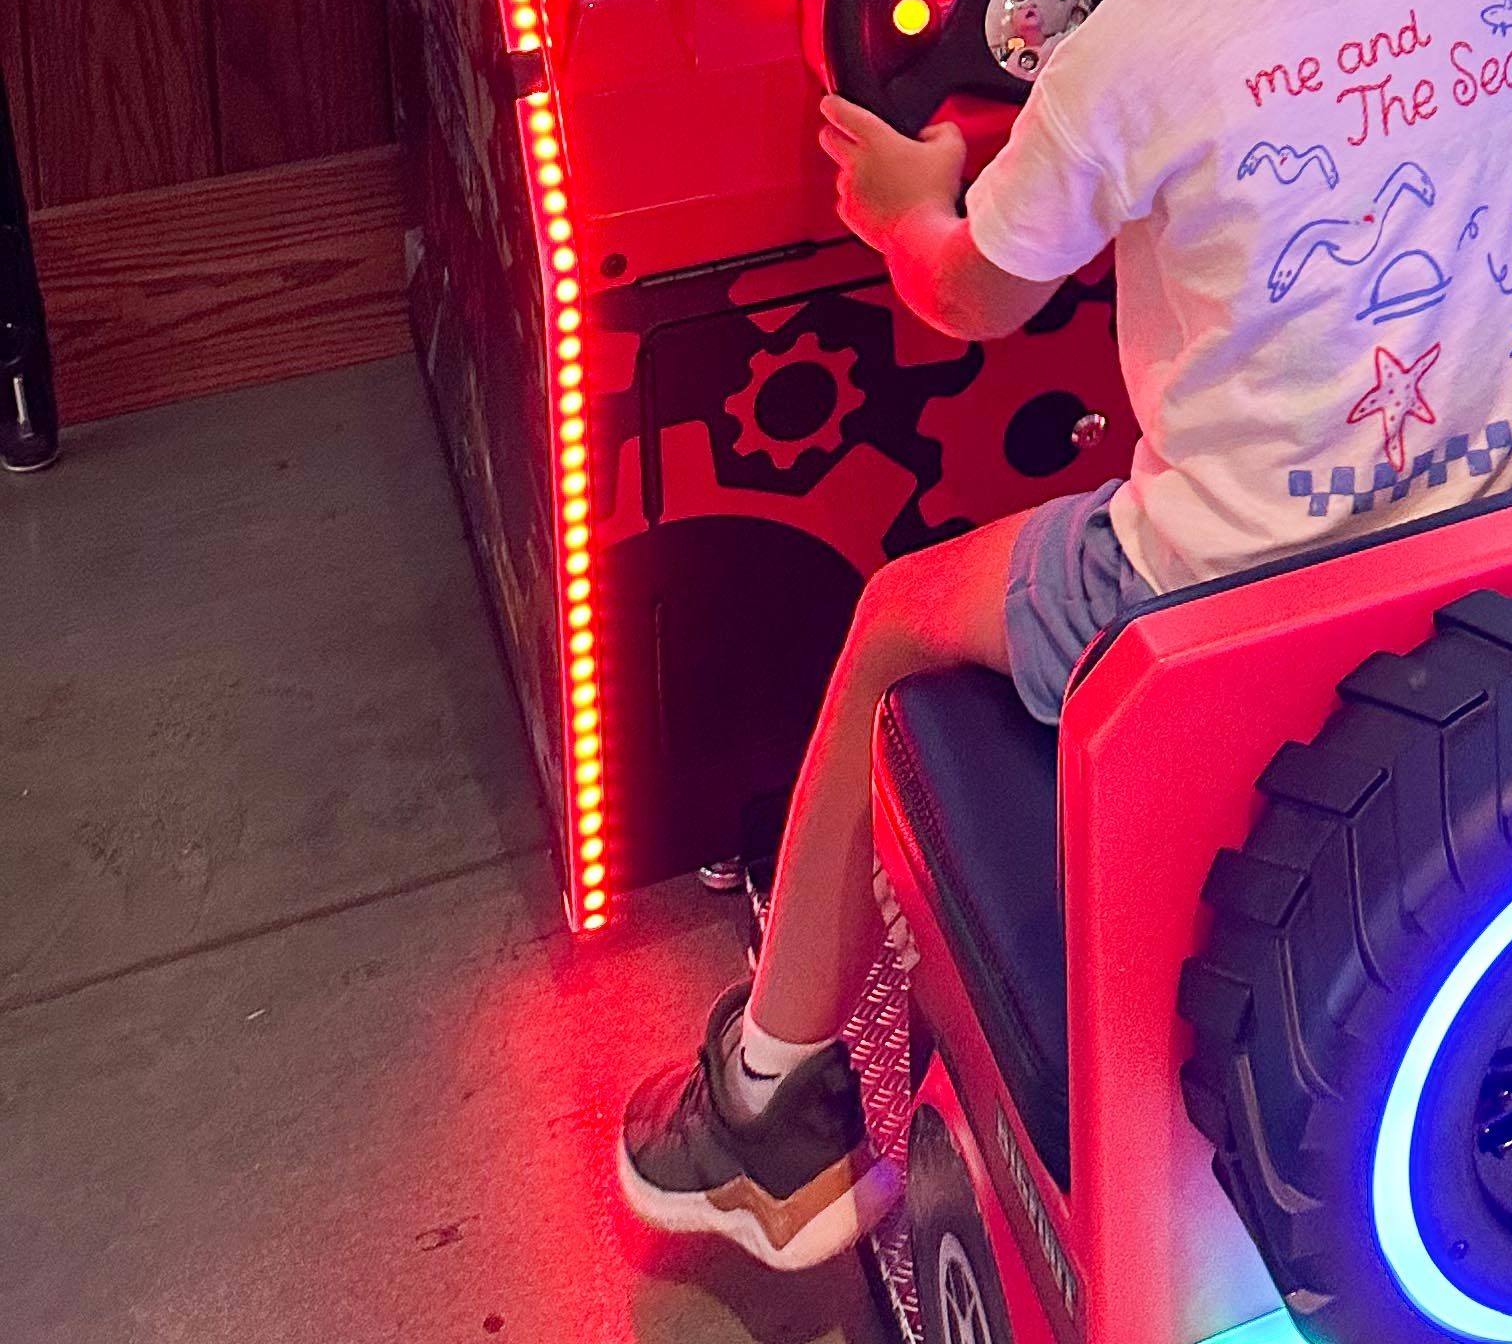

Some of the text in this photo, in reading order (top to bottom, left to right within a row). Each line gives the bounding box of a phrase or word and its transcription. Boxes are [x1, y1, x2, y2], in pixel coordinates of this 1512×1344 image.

[1246, 9, 1431, 107] me and
[1336, 73, 1438, 146] The
